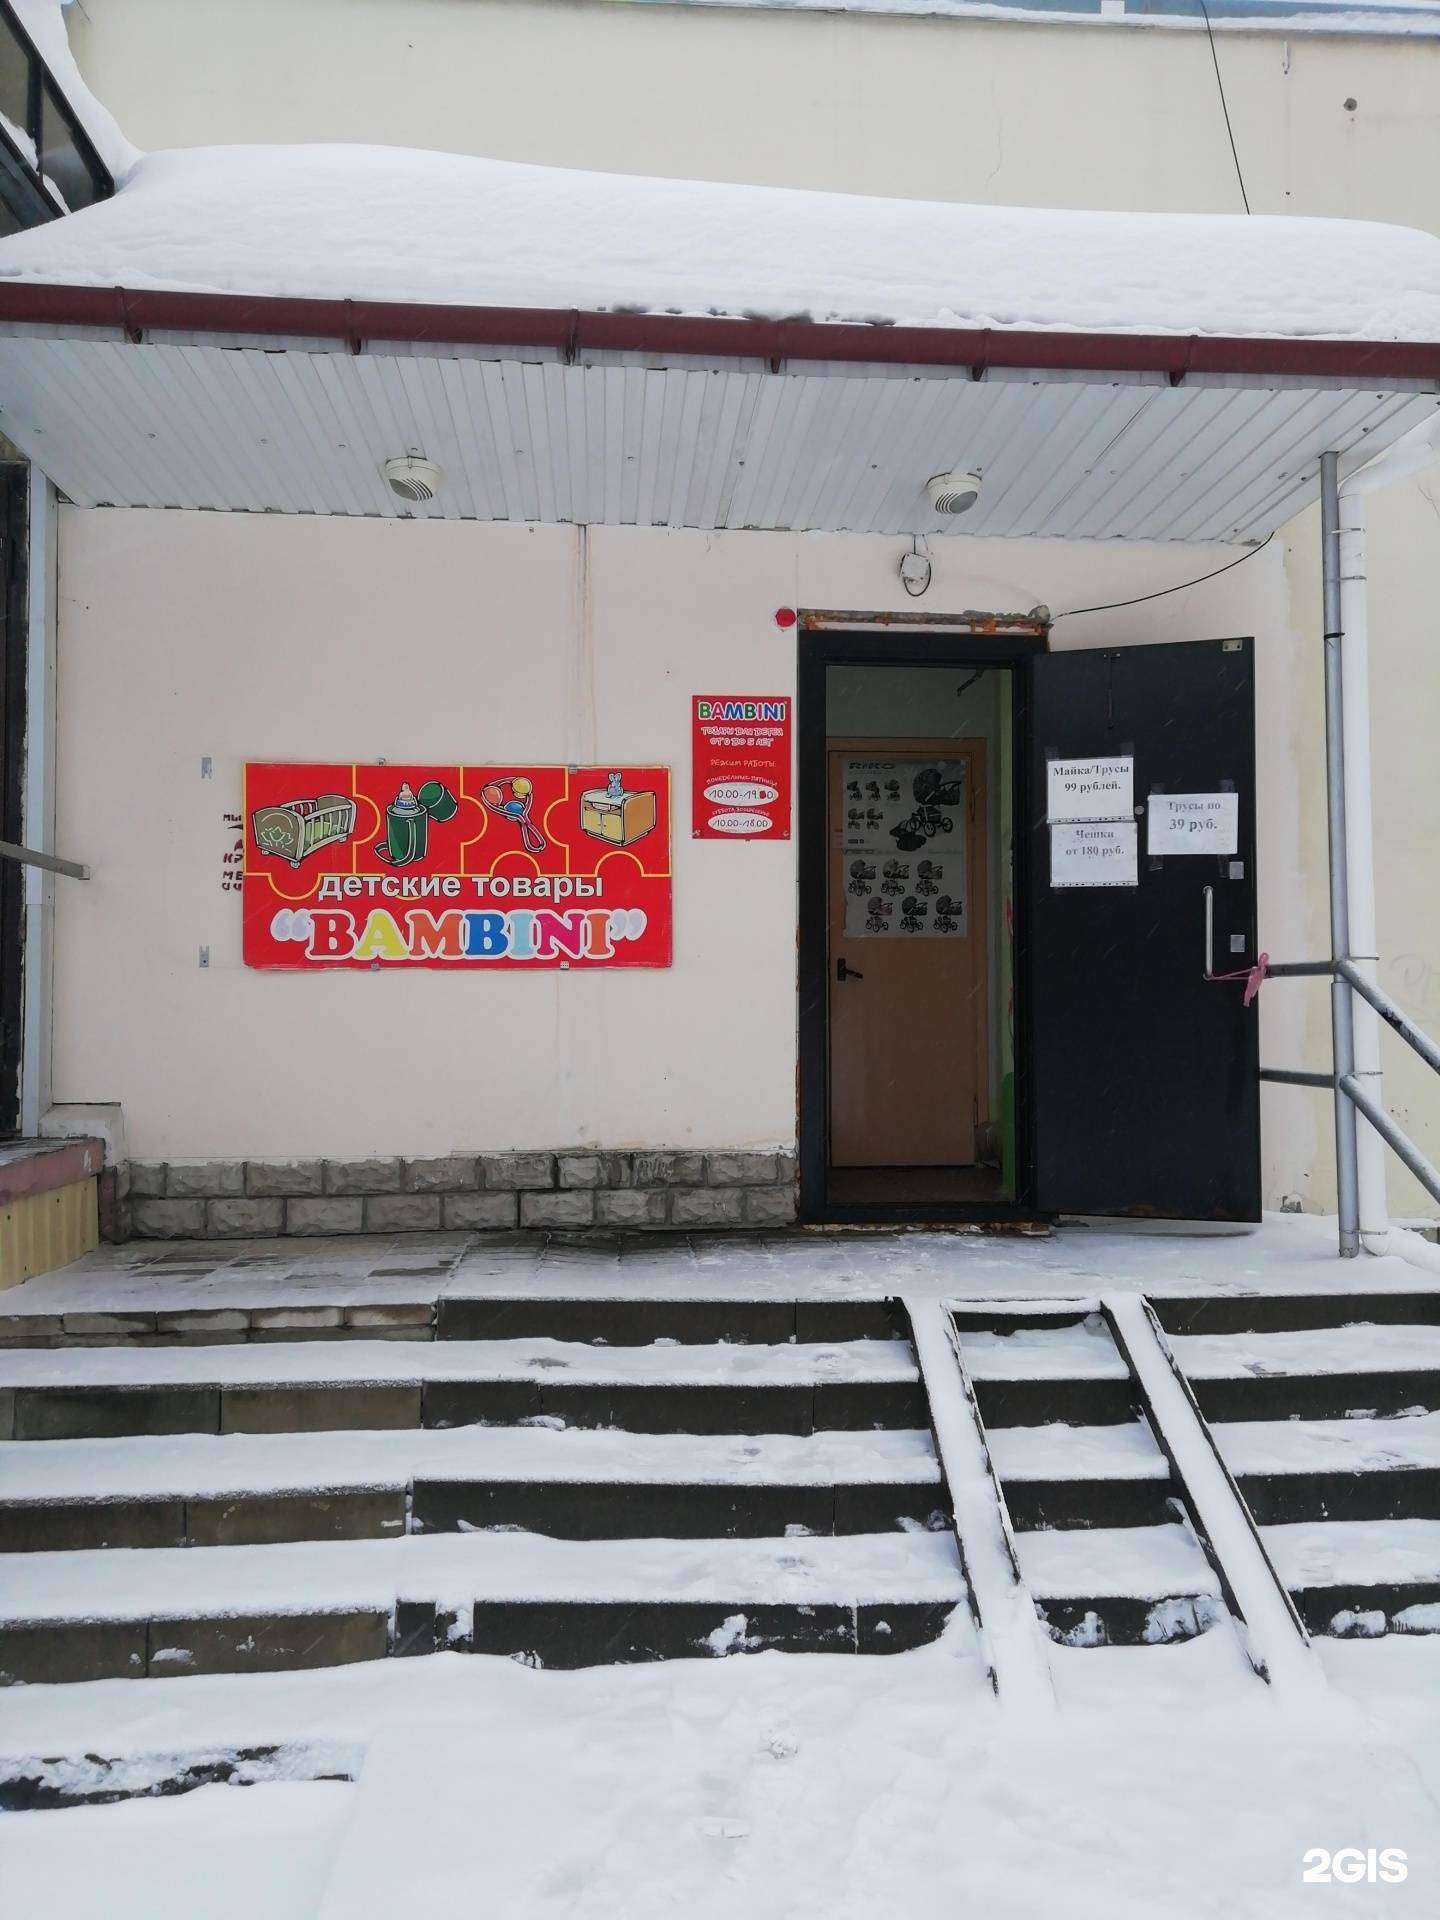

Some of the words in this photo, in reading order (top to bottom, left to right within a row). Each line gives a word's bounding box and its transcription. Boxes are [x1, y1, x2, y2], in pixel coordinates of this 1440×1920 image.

[698, 701, 785, 721] BAMBINI
[1064, 782, 1078, 792] 99
[1079, 781, 1121, 794] рублей.
[709, 789, 774, 800] 10.00-19.0
[1168, 802, 1204, 813] Трусы
[1169, 819, 1185, 830] 39
[1189, 818, 1218, 832] руб.
[1065, 848, 1078, 856] от
[1082, 846, 1098, 857] 180
[1101, 845, 1125, 858] руб.
[317, 874, 461, 901] детские
[471, 875, 603, 903] товары
